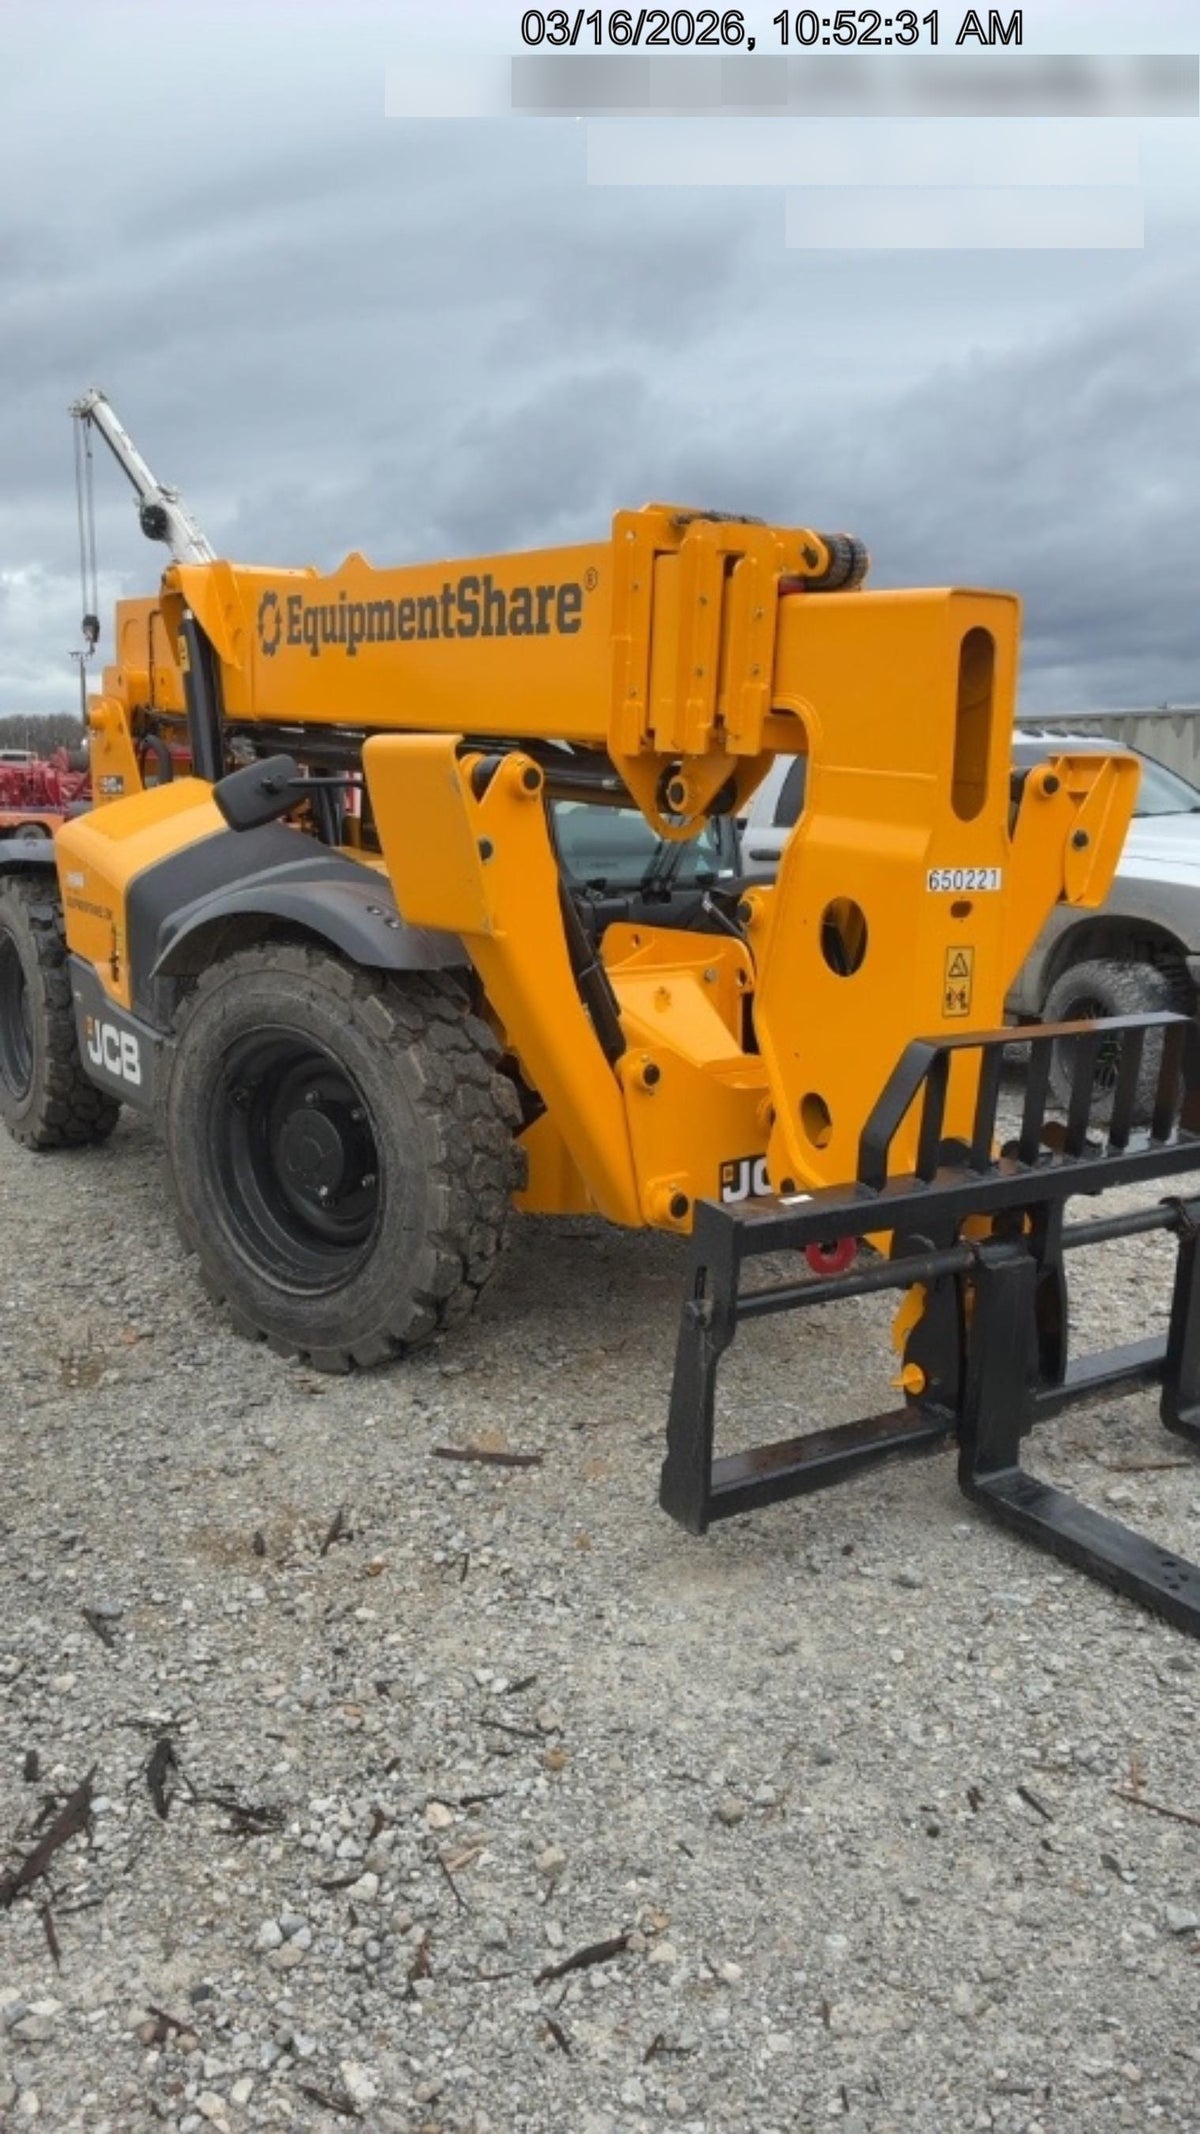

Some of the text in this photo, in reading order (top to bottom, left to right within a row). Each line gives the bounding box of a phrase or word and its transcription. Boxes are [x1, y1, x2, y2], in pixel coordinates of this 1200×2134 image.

[929, 869, 997, 891] 650221
[87, 1018, 141, 1086] JCB
[722, 1156, 774, 1203] JC
